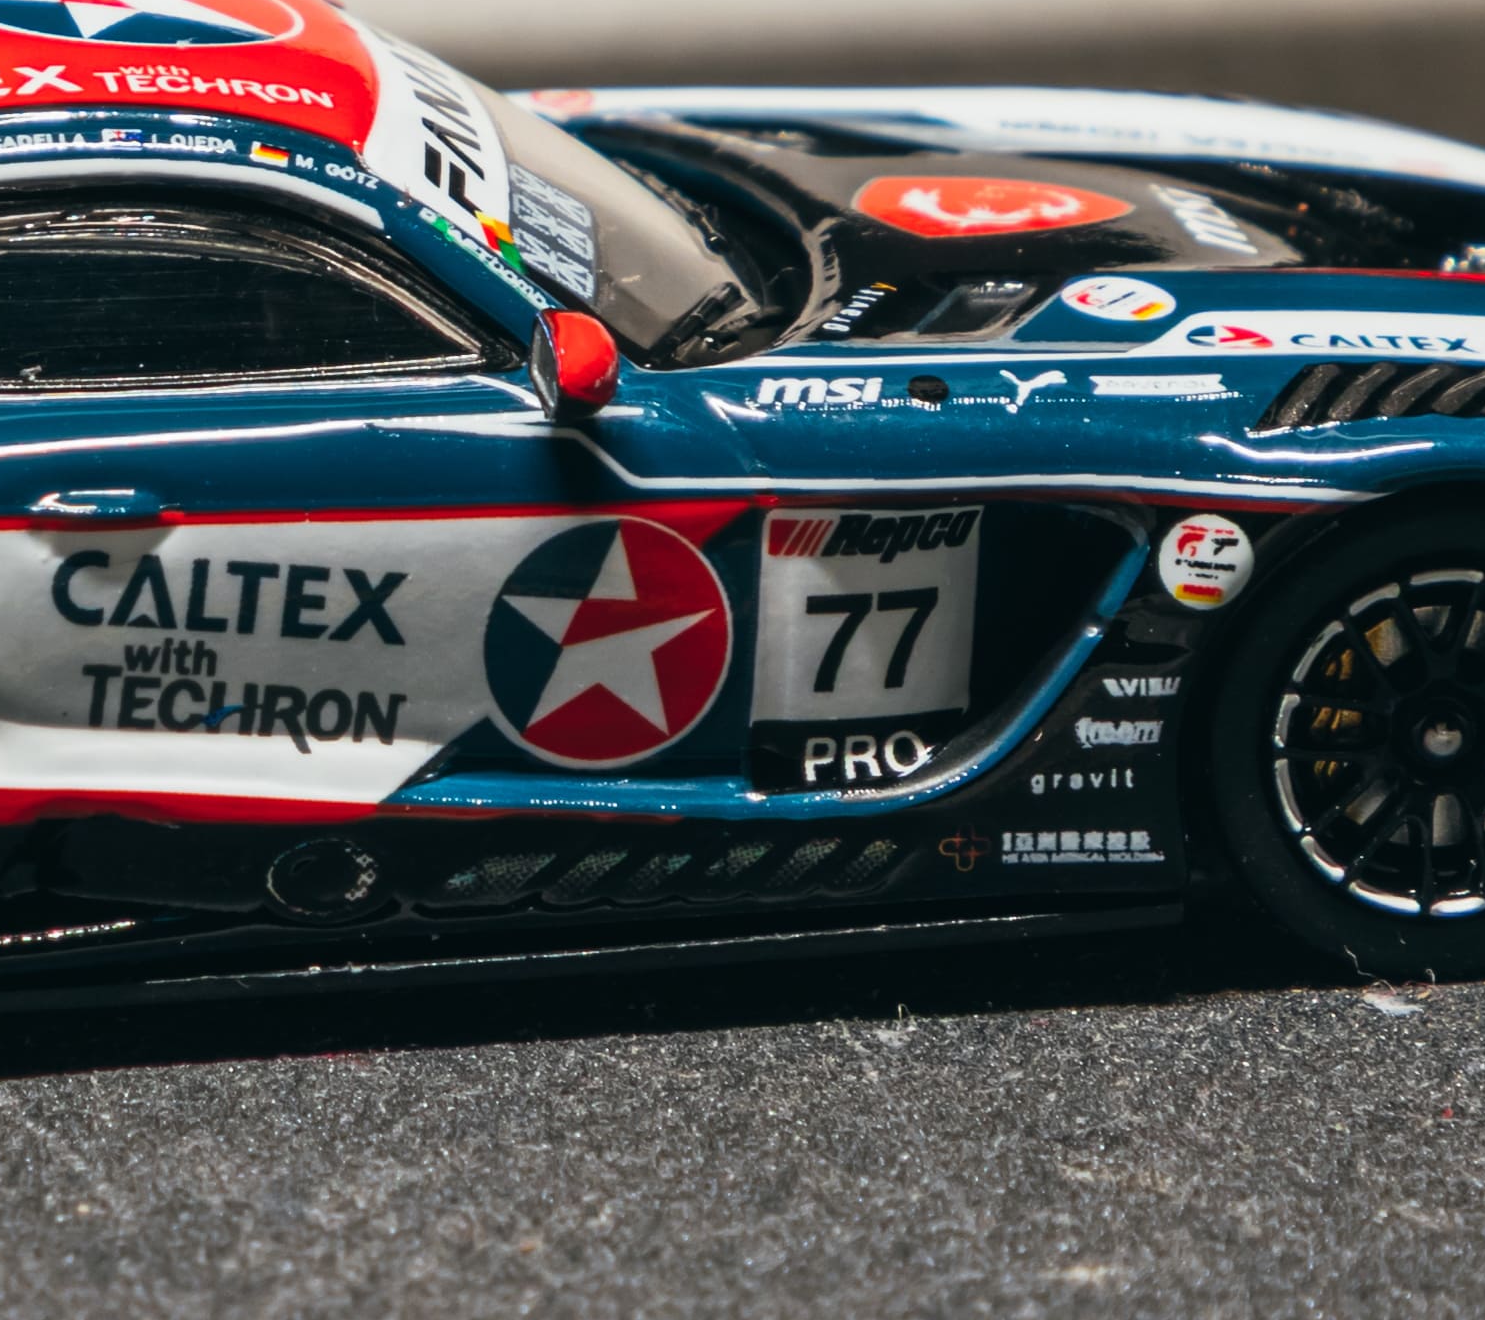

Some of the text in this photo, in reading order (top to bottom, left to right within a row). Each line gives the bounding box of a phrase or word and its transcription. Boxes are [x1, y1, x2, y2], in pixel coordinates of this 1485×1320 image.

[92, 72, 335, 109] TECHRON
[119, 65, 190, 77] with
[295, 154, 379, 190] M. GÖTZ
[1149, 183, 1259, 255] msi
[1289, 333, 1482, 355] CALTEX
[756, 377, 884, 403] msi
[820, 510, 982, 565] Repco
[50, 549, 412, 646] CALTEX
[122, 637, 217, 677] with
[805, 585, 939, 694] 77
[80, 663, 407, 754] TECHRON
[803, 729, 931, 782] PRO
